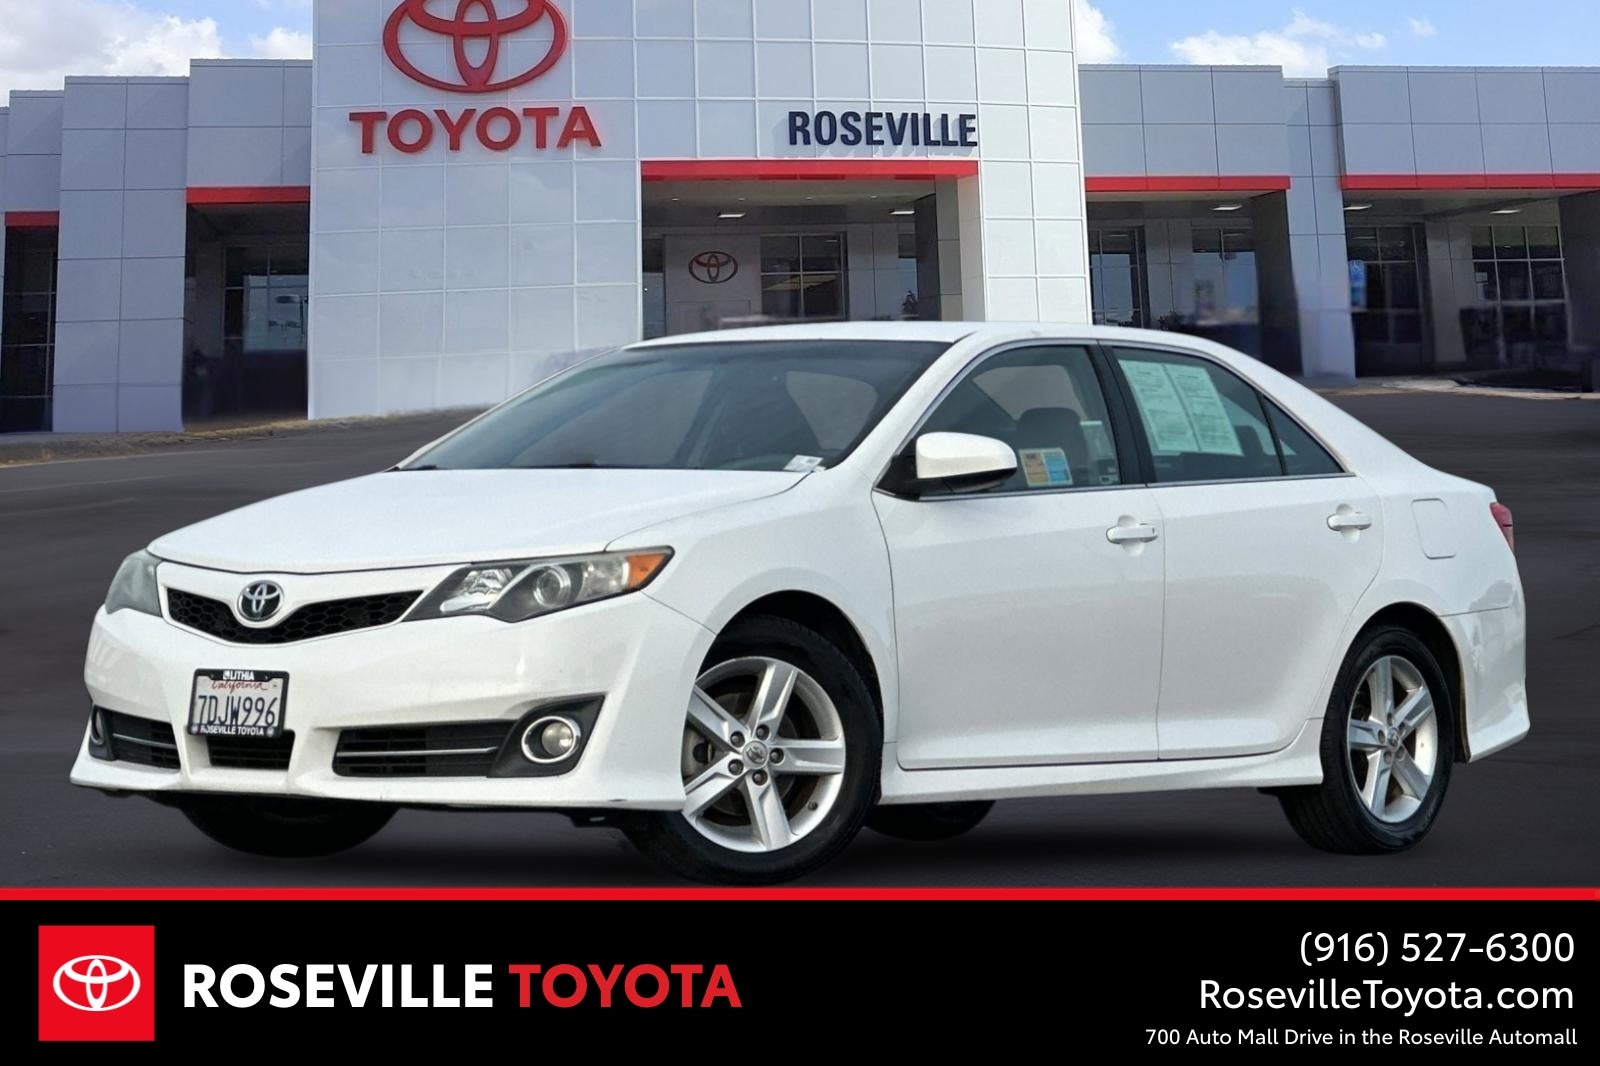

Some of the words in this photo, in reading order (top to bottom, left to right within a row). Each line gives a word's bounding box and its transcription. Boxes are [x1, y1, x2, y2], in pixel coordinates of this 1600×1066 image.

[349, 105, 602, 154] TOYOTA
[788, 110, 978, 147] ROSEVILLE
[212, 680, 268, 694] California
[230, 670, 255, 681] LITHIA
[197, 694, 278, 727] 7DJW996
[200, 725, 236, 735] ROSEVILLE
[237, 726, 264, 736] TOYOTA
